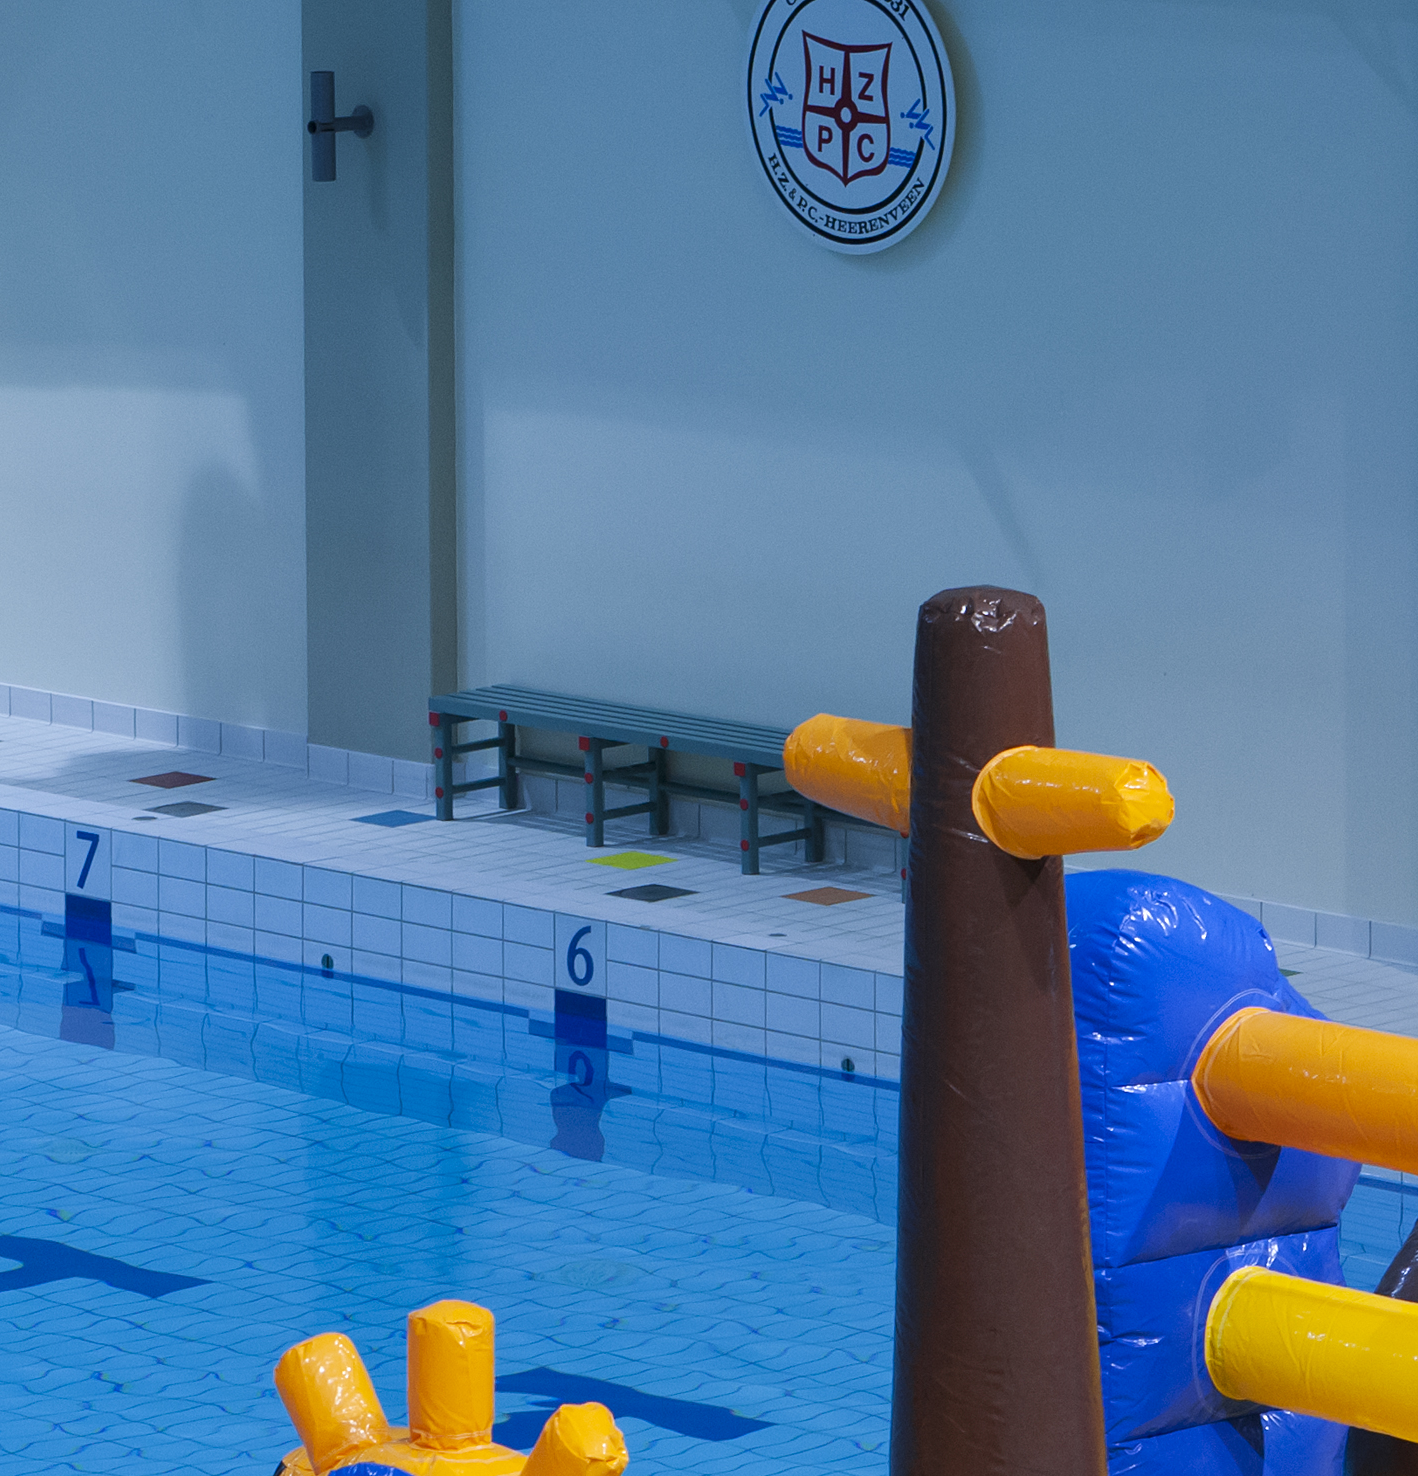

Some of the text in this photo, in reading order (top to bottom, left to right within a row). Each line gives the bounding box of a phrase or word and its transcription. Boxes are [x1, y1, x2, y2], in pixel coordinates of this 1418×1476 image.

[818, 65, 874, 102] H Z
[817, 125, 875, 163] P C
[76, 830, 100, 890] 7
[566, 925, 594, 987] 6
